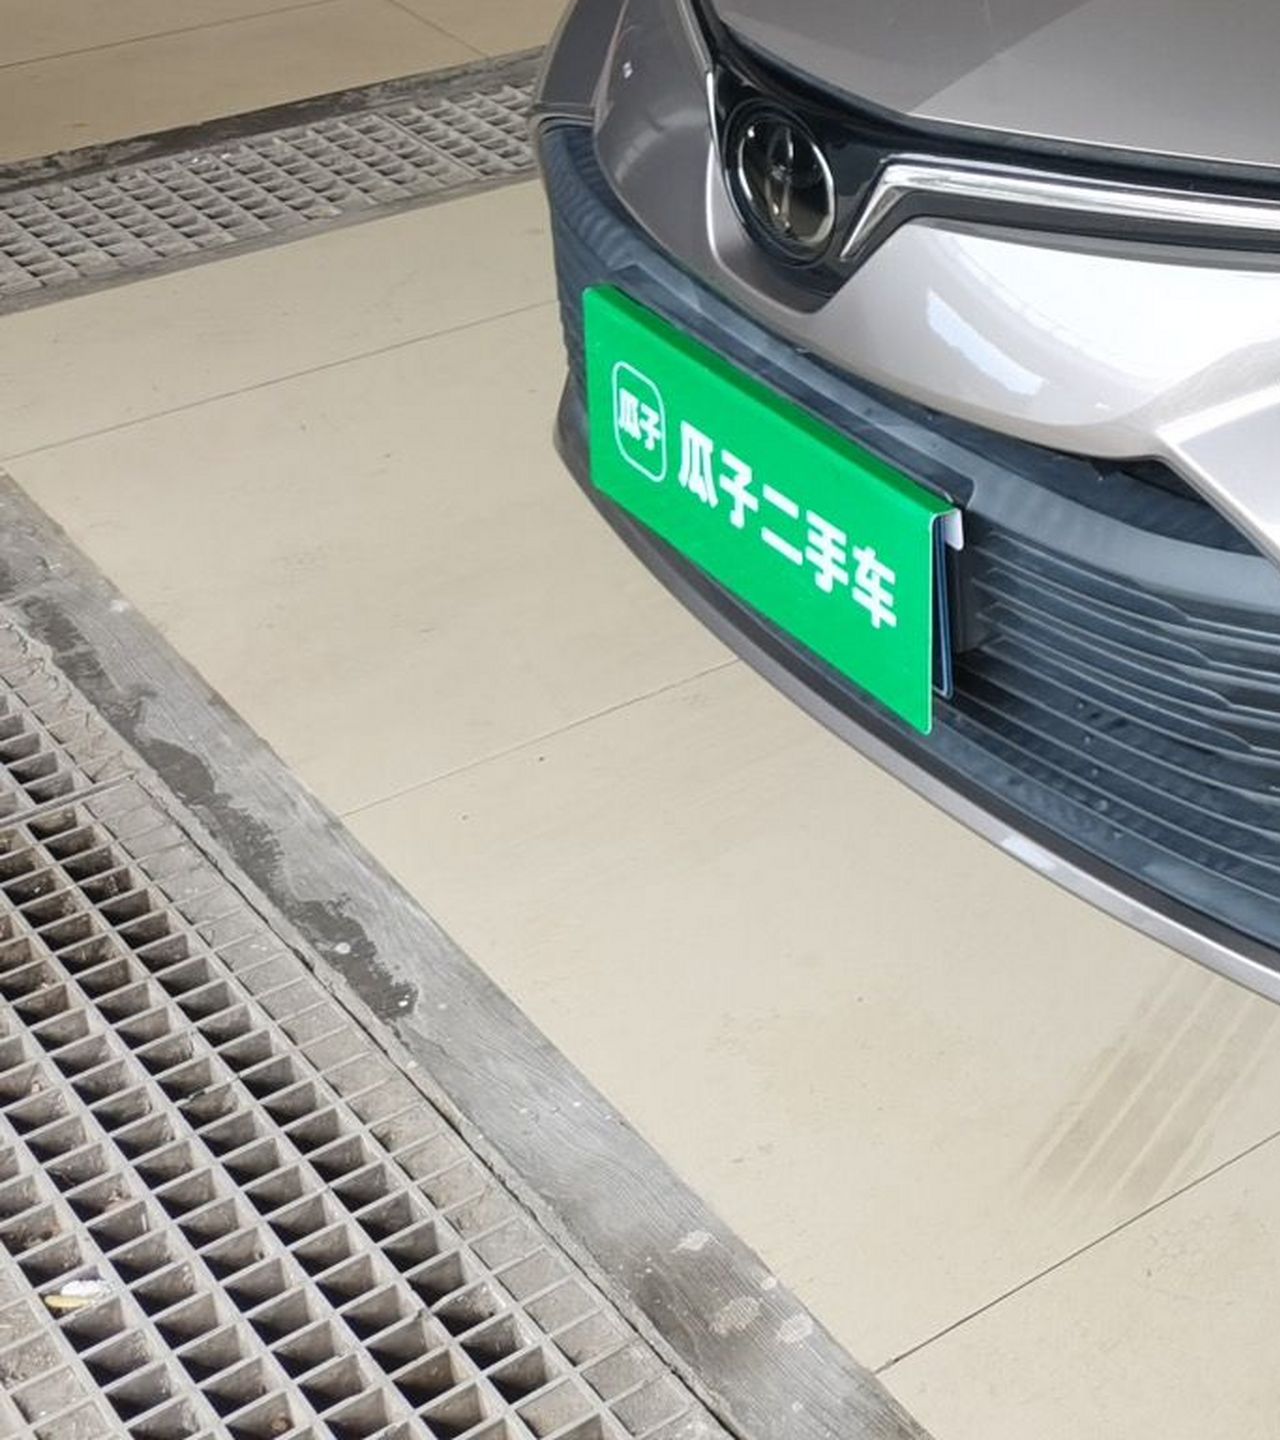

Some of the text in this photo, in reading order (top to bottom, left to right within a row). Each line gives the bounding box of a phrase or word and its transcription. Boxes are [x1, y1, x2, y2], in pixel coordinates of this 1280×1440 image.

[617, 389, 662, 451] 瓜子
[678, 421, 898, 629] 瓜子二手车
